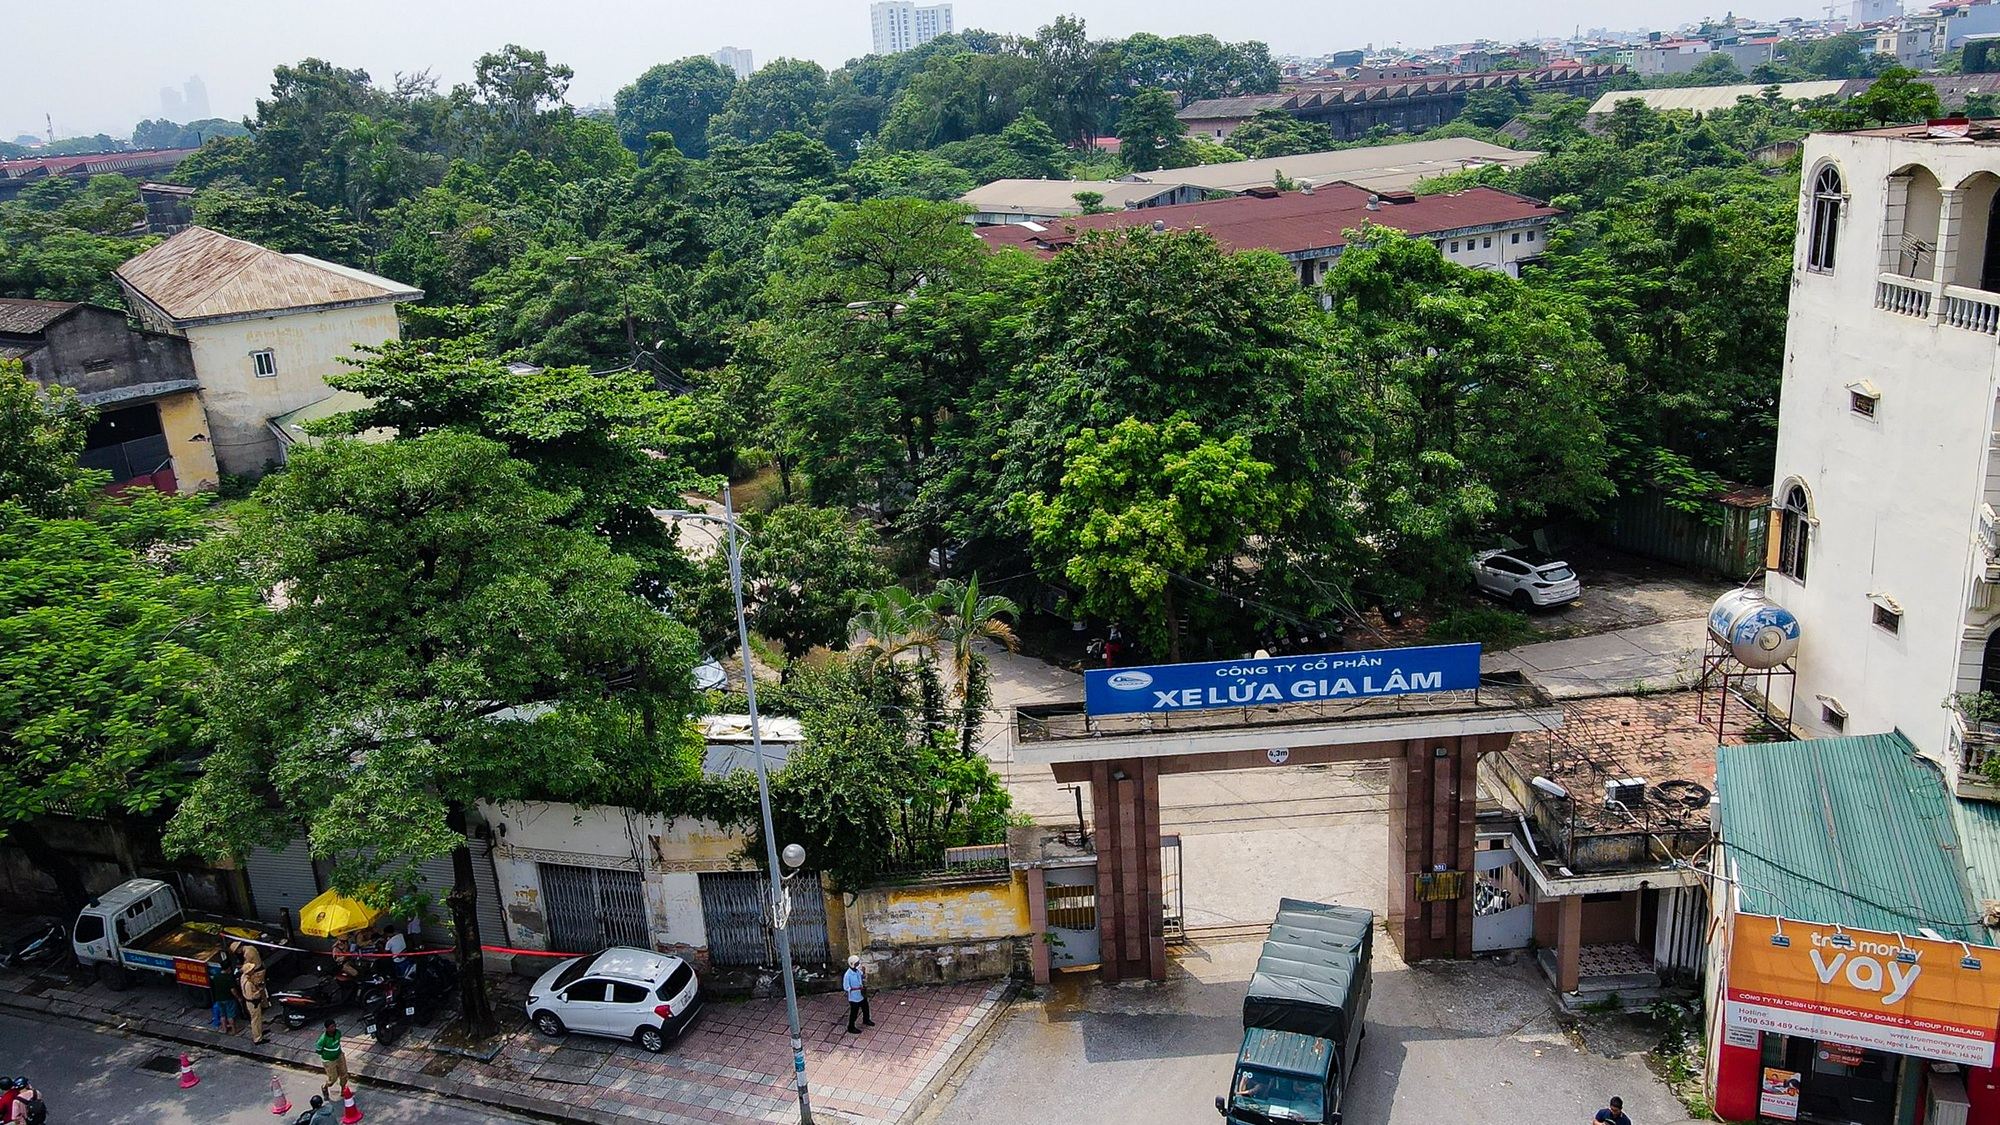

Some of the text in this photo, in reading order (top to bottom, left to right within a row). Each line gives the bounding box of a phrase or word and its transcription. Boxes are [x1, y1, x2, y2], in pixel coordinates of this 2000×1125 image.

[1216, 654, 1382, 676] CÔNG TY CỔ PHẦN
[1153, 668, 1442, 708] XE LỬA GIA LÂM
[1810, 948, 1922, 1004] vay
[1738, 1016, 1758, 1024] 1900
[1739, 993, 1760, 1002] CÔNG
[1914, 1021, 1941, 1029] GROUP
[1943, 1025, 1984, 1037] (THAILAND)
[1890, 1032, 1984, 1052] www.truemoneyvay.com
